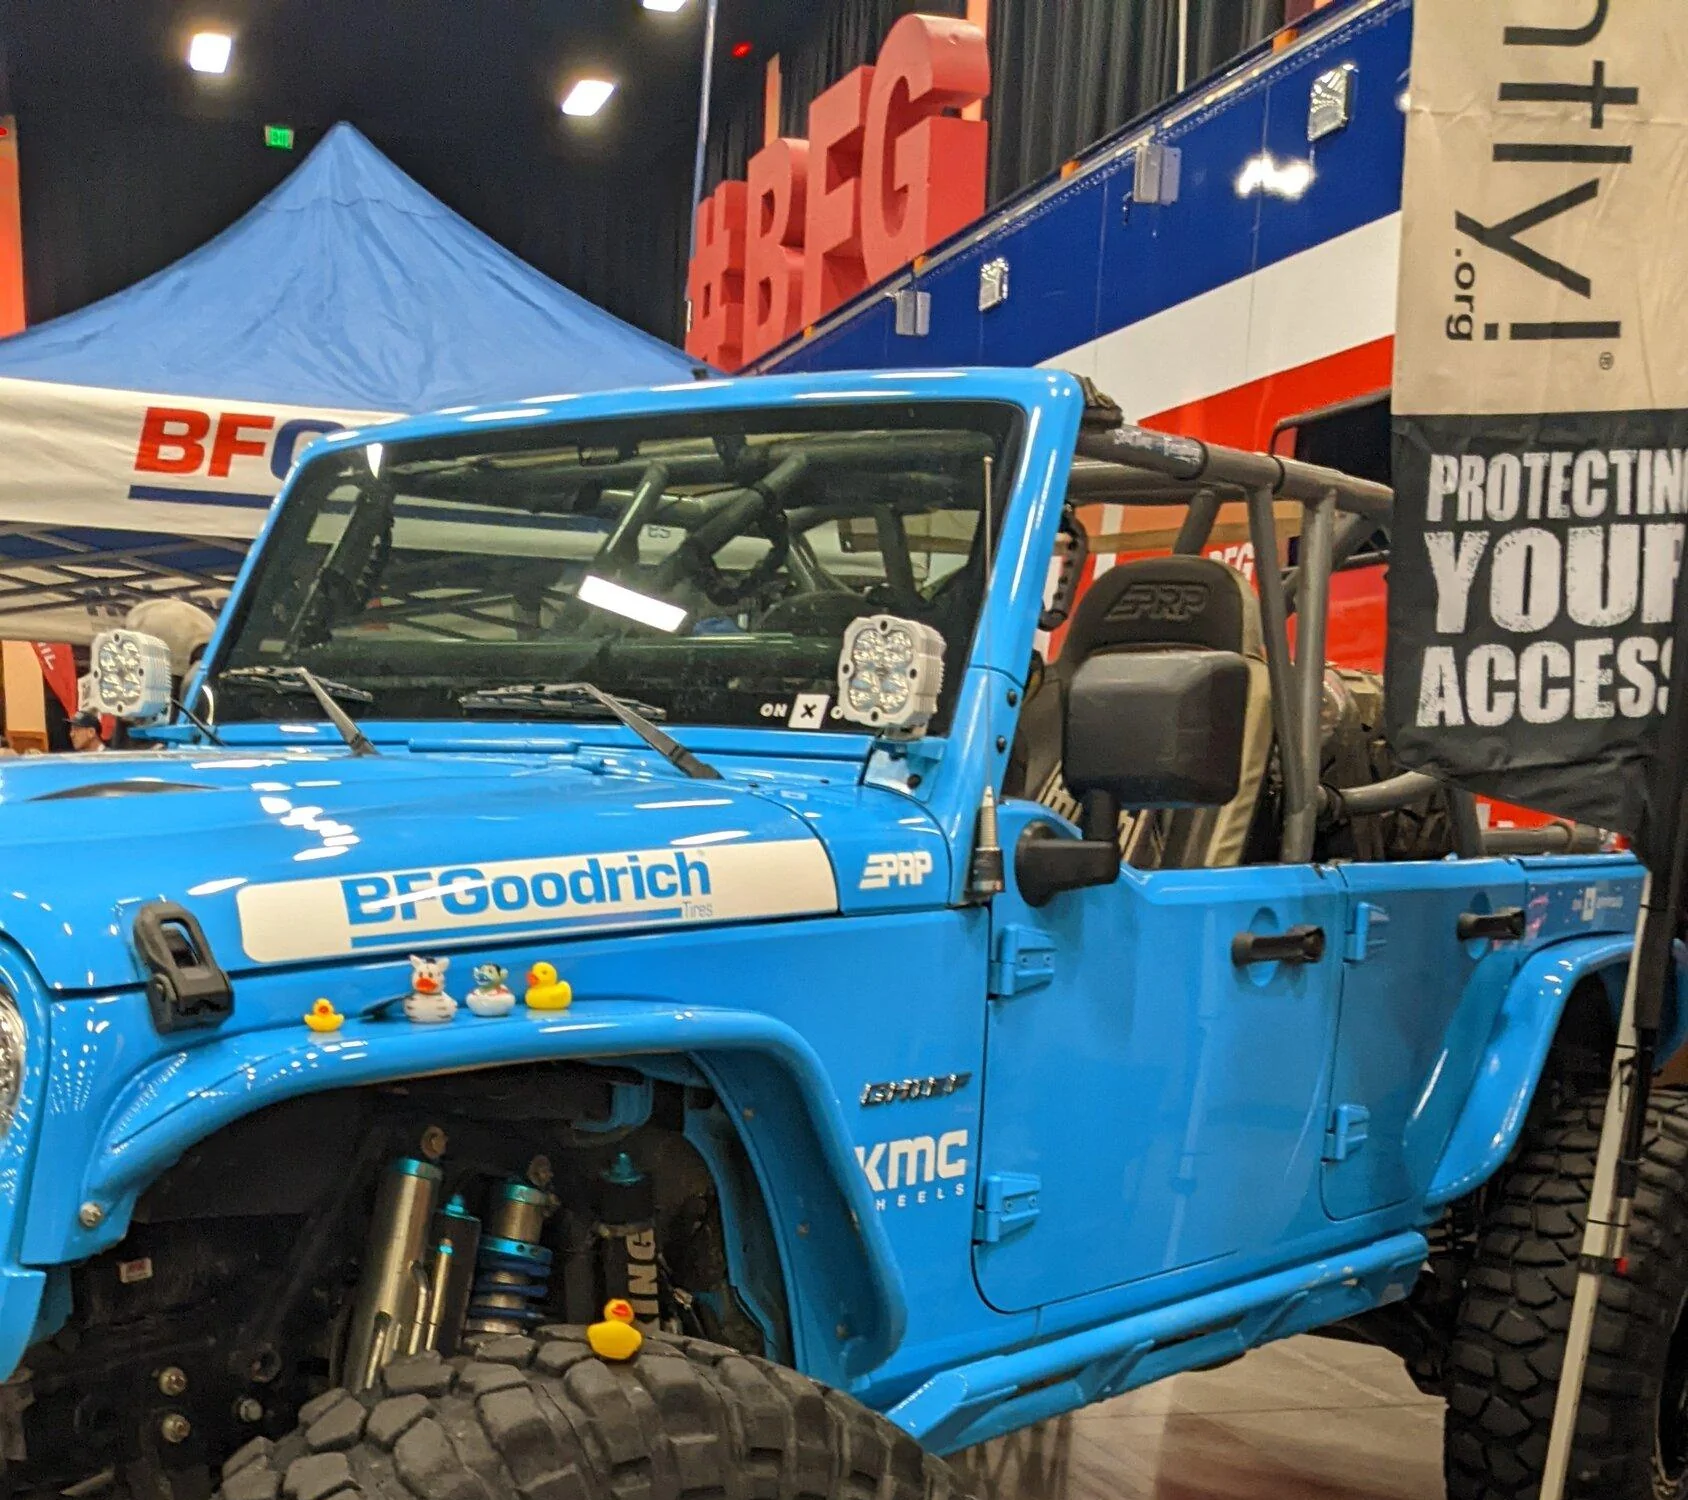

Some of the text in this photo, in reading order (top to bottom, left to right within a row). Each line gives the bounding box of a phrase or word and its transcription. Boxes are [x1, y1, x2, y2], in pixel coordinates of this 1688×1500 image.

[1446, 248, 1476, 341] .org
[1426, 448, 1688, 521] PROTECTIN
[760, 703, 788, 718] ON
[830, 706, 844, 720] O
[340, 851, 712, 926] BFGoodrich
[682, 900, 713, 919] Tires
[854, 1129, 969, 1193] KMC
[875, 1183, 965, 1211] HEELS
[627, 1227, 660, 1330] ING
